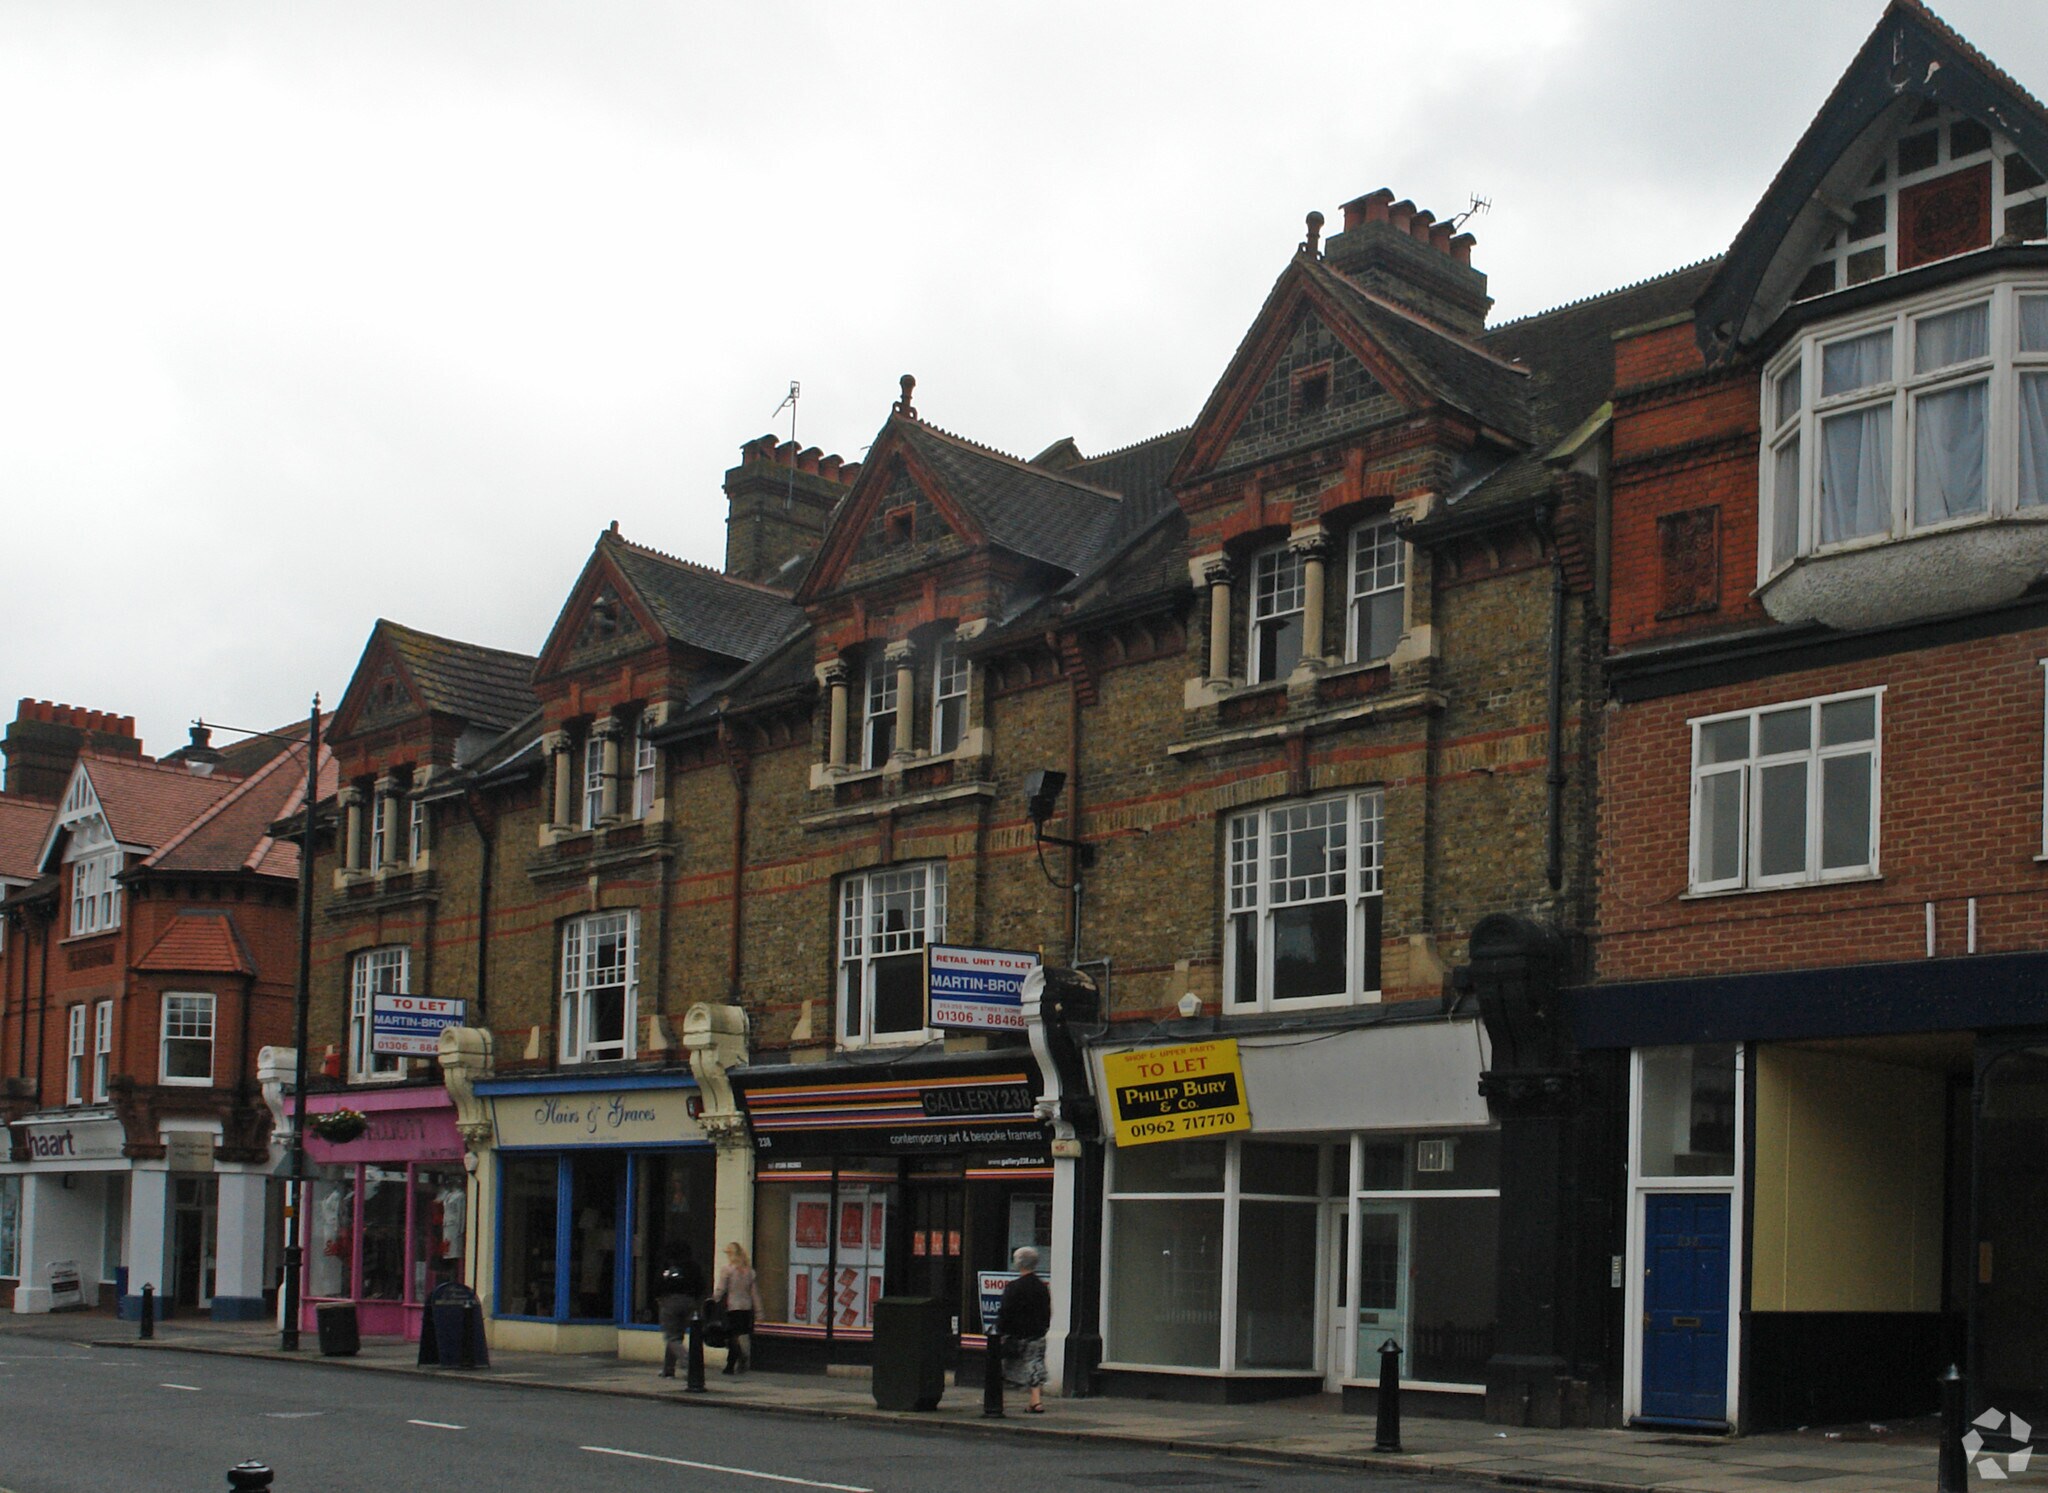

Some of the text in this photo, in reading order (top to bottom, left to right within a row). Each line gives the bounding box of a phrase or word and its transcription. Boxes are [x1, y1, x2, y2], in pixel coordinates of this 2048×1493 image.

[936, 955, 1032, 969] RETAIL UNIT TO LET
[931, 974, 1023, 993] MARTIN-BROW
[392, 999, 447, 1011] TO LET
[937, 1010, 973, 1023] 01306
[378, 1041, 408, 1051] 01306
[419, 1043, 438, 1053] 884
[1124, 1053, 1147, 1062] SHOP
[1160, 1048, 1187, 1058] UPPER
[1190, 1045, 1216, 1054] PARTS
[1137, 1056, 1208, 1078] TO LET
[923, 1088, 1031, 1113] GALLERY238
[1125, 1080, 1227, 1105] PHILIP BURY
[608, 1095, 656, 1128] Graces
[1160, 1101, 1171, 1113] &
[1131, 1112, 1235, 1137] 01962 717770
[28, 1129, 75, 1157] haart
[758, 1137, 772, 1148] 238
[890, 1132, 947, 1145] contemporary
[950, 1132, 961, 1143] art
[962, 1130, 970, 1142] &
[970, 1130, 1006, 1143] bespoke
